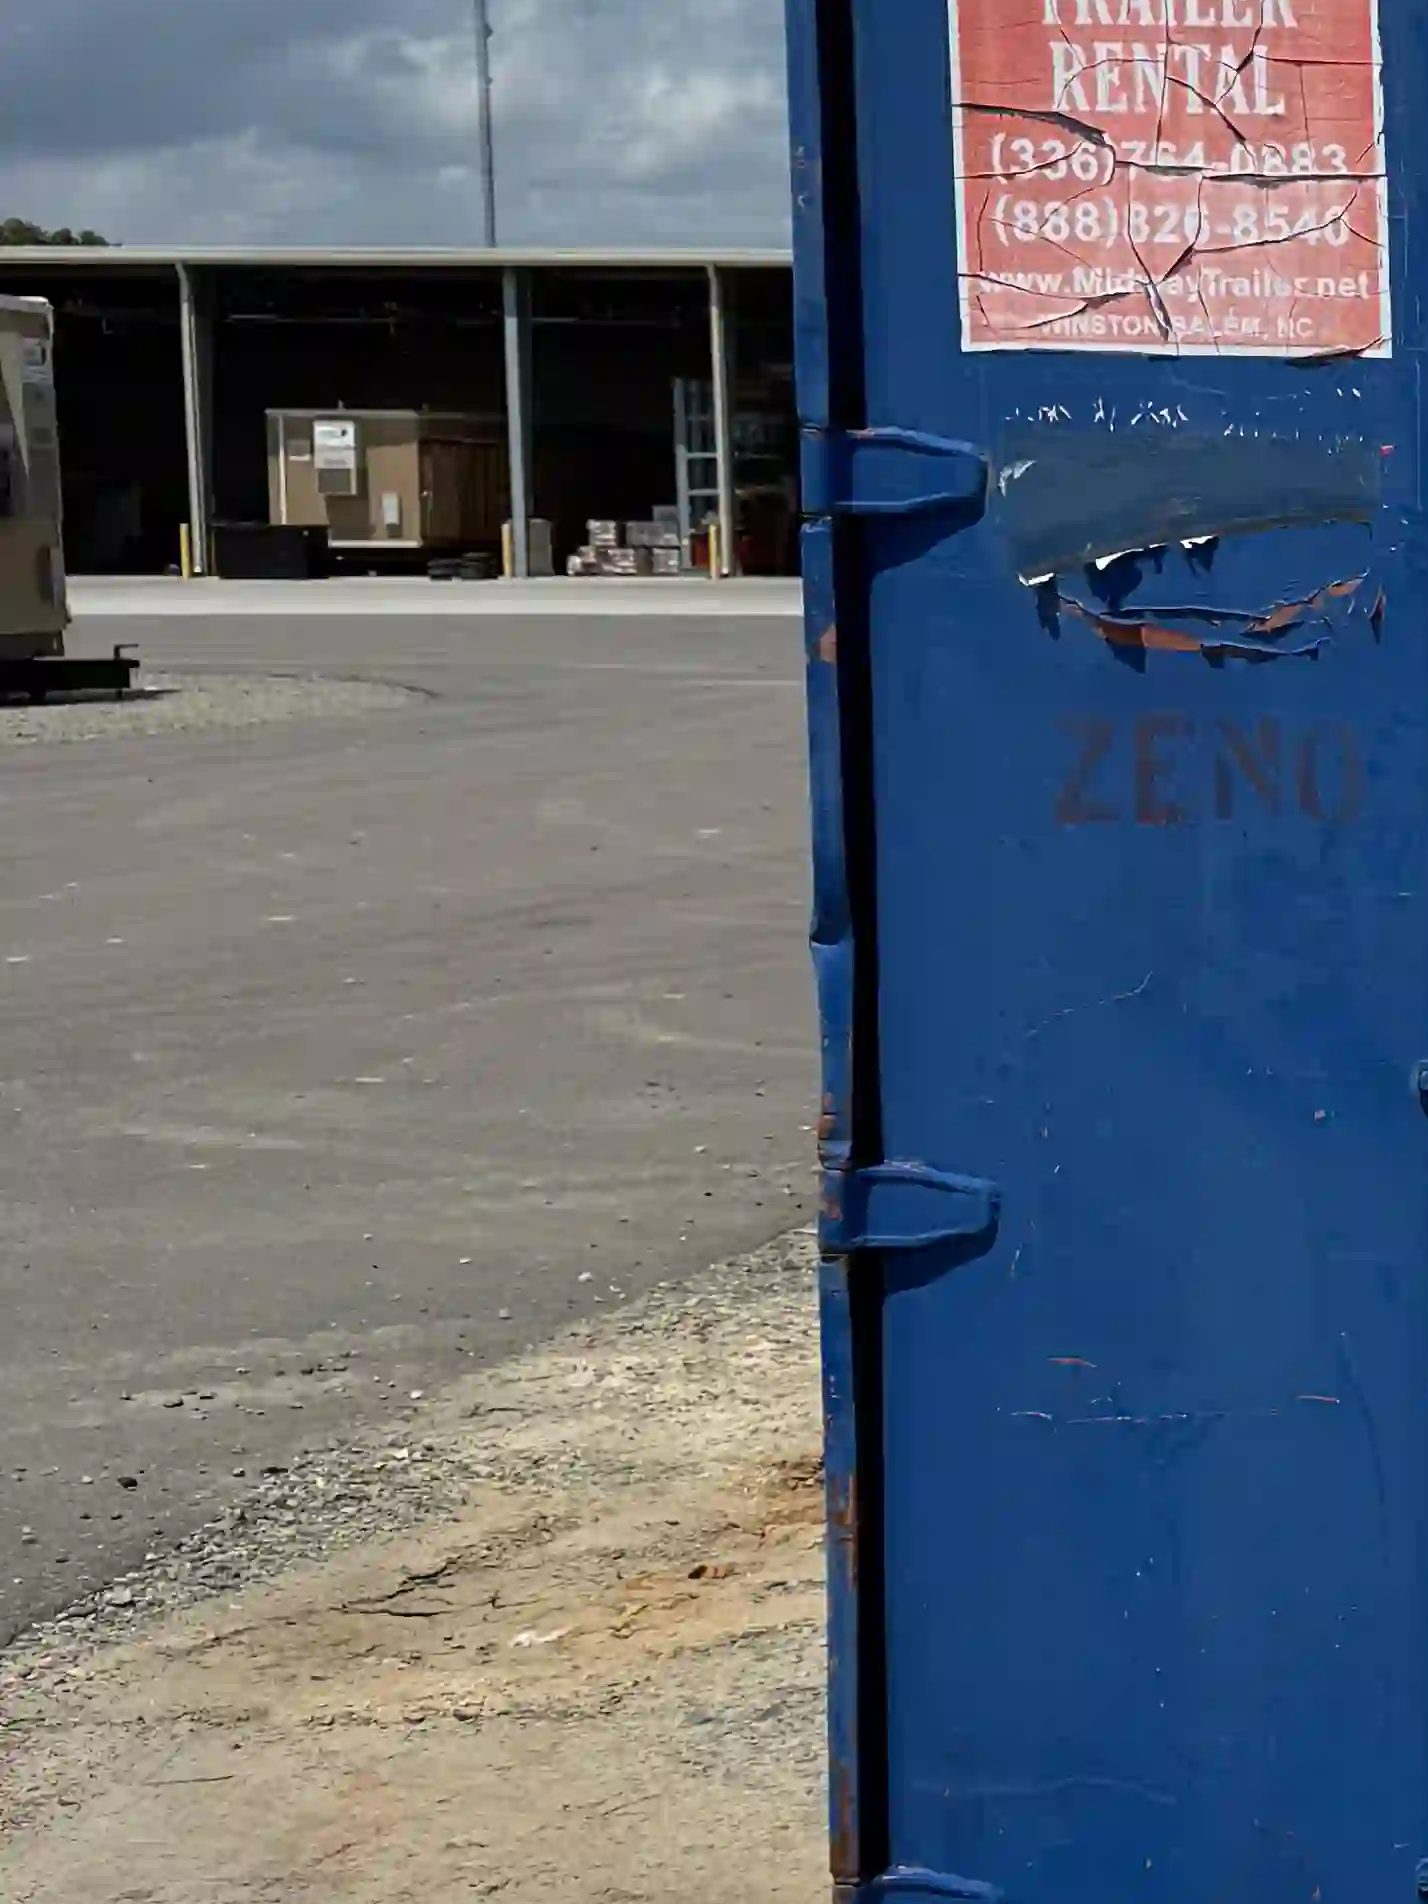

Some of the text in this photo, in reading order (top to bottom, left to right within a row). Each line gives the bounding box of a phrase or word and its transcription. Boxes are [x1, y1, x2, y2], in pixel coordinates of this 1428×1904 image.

[1050, 41, 1285, 116] RENTAL
[995, 195, 1350, 247] (888)826-8540
[1277, 317, 1313, 338] NC
[1049, 709, 1368, 828] ZENO
